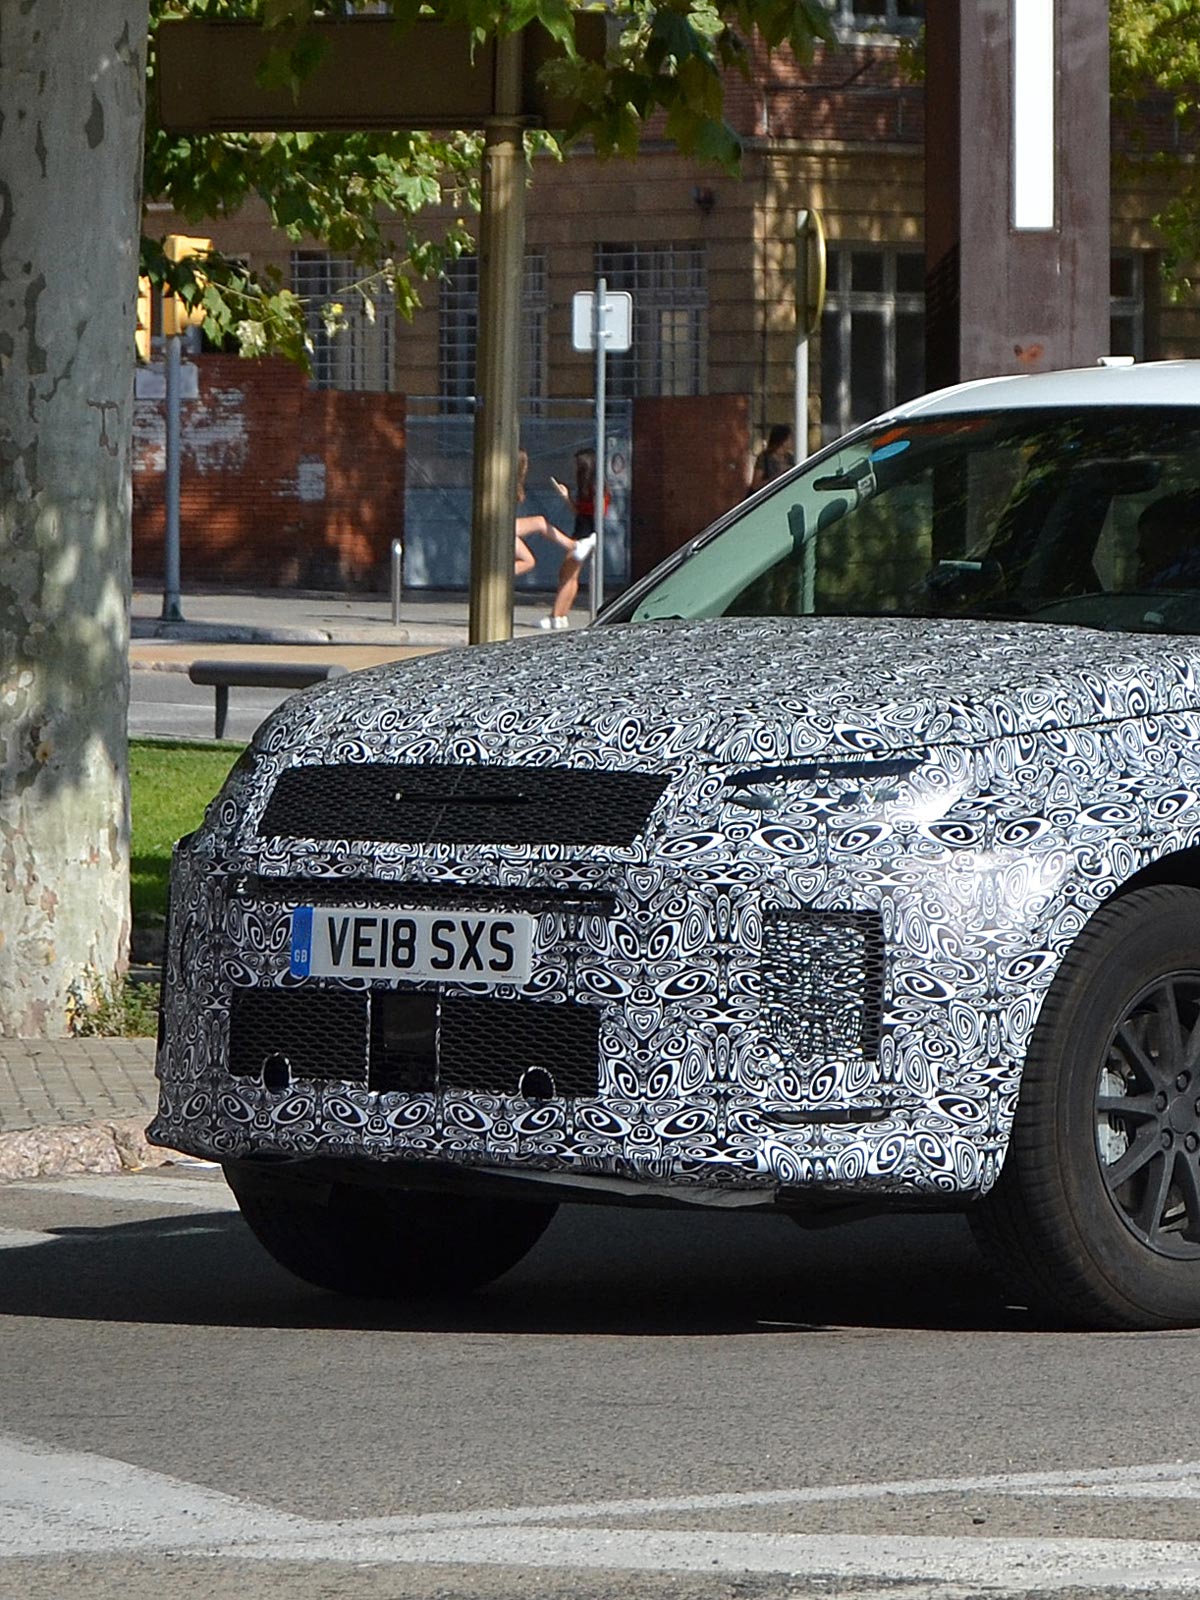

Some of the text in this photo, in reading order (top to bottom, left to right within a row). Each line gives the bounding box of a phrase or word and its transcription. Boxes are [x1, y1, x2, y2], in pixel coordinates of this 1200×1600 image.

[294, 949, 308, 963] GB
[328, 916, 514, 972] VE18 SXS
